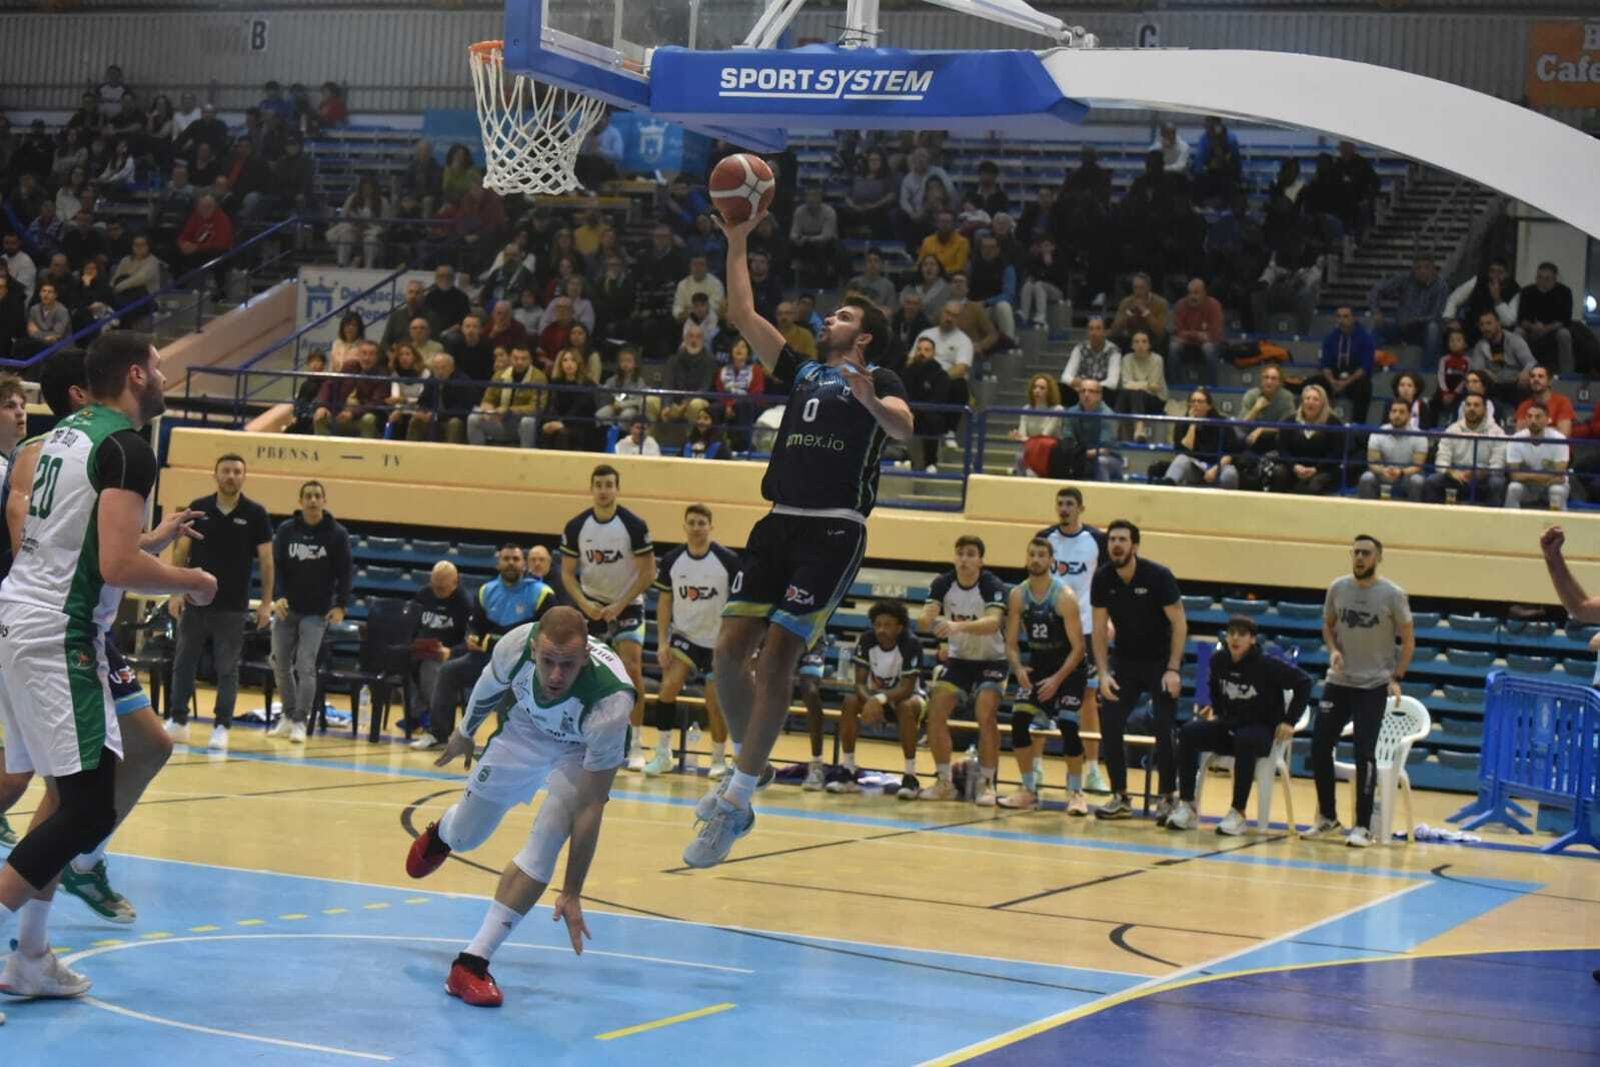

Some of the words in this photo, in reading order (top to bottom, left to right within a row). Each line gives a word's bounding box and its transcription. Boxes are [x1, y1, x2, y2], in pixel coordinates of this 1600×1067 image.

[251, 20, 267, 50] B
[802, 398, 820, 422] 0
[256, 446, 320, 462] PRENSA
[30, 455, 63, 519] 20
[586, 550, 623, 564] UDEA
[731, 570, 744, 593] 0
[679, 585, 719, 601] UDEA
[1032, 624, 1048, 639] 22
